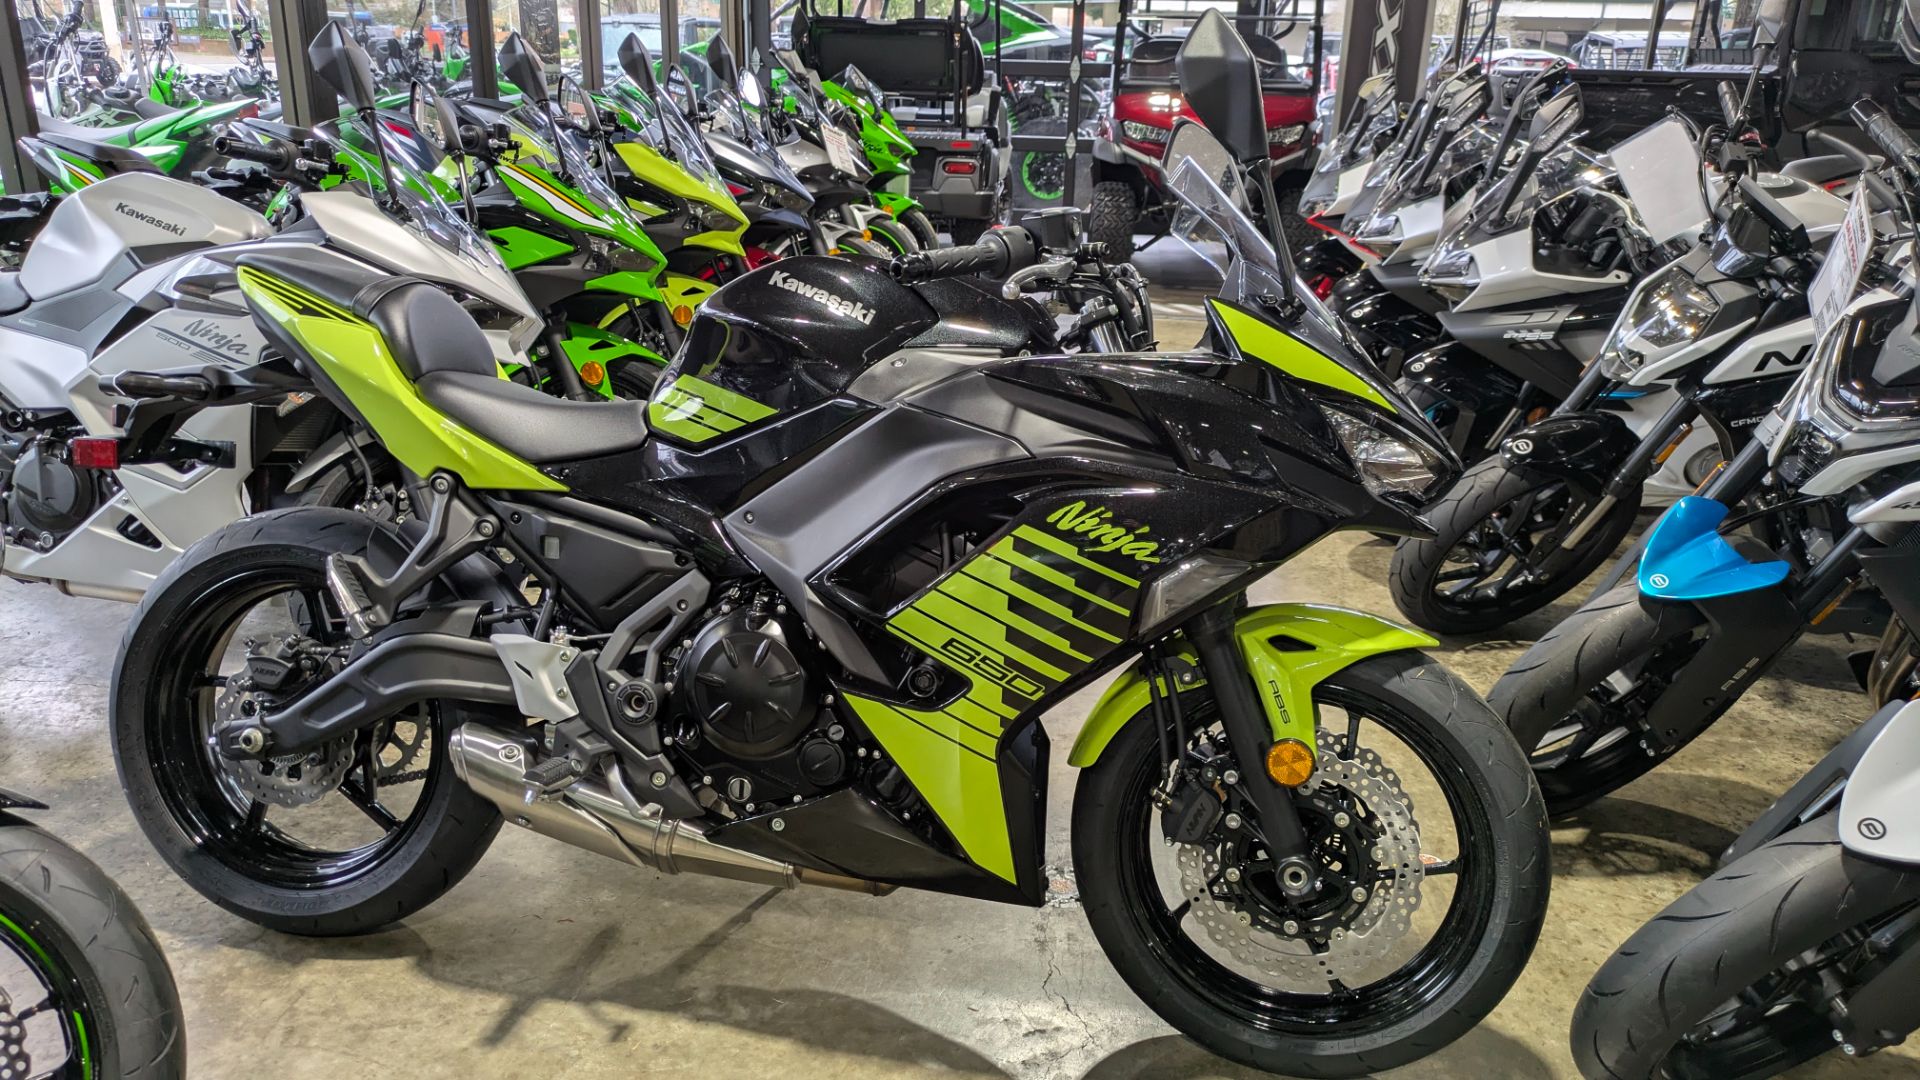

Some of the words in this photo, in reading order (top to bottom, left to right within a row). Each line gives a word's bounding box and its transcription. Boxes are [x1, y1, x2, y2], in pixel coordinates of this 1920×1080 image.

[115, 202, 187, 236] Kawasaki
[768, 270, 877, 326] Kawasaki
[183, 318, 250, 356] Ninja
[1046, 501, 1161, 564] Ninja
[940, 637, 1045, 698] 650
[1720, 656, 1760, 691] ABS
[1268, 680, 1291, 724] ABS
